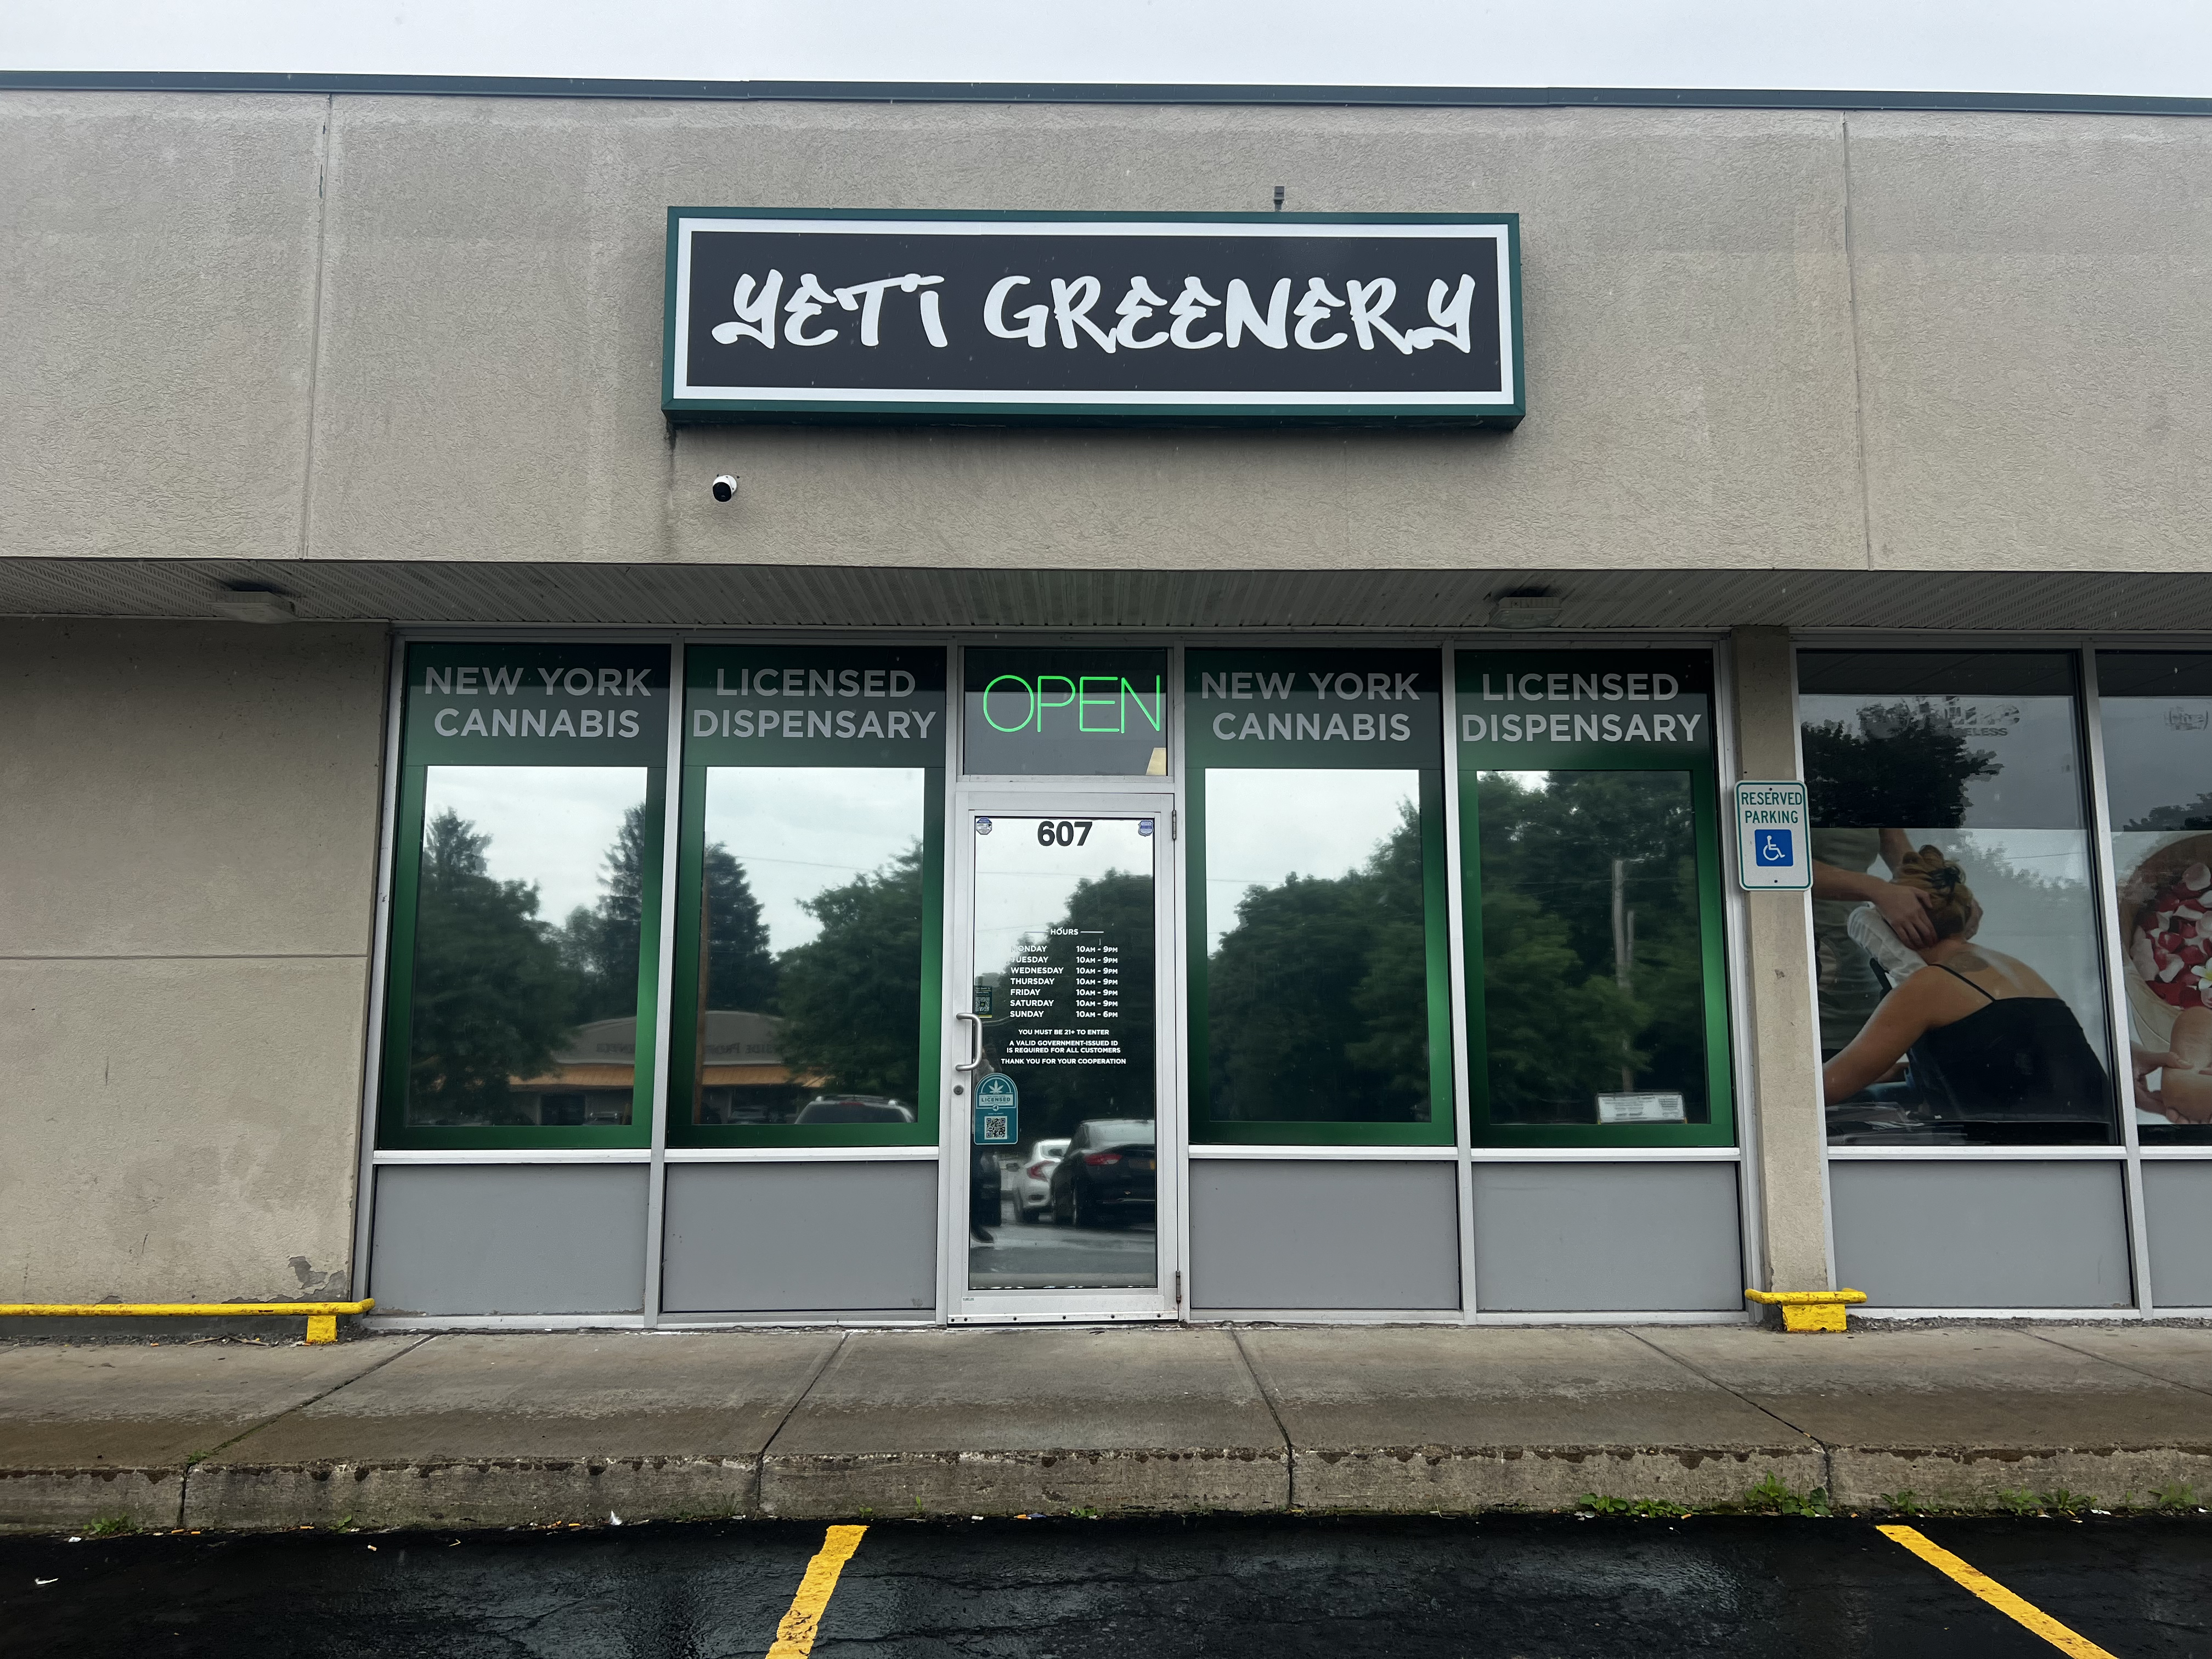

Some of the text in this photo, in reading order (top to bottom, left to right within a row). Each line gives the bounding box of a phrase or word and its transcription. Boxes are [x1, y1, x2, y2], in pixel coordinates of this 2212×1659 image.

[983, 274, 1476, 356] GREENERY
[425, 667, 651, 696] NEW YORK
[716, 668, 915, 698] LICENSED
[1201, 672, 1420, 701] NEW YORK
[1483, 672, 1679, 702] LICENSED
[983, 674, 1160, 733] OPEN
[435, 708, 639, 738] CANNABIS
[693, 708, 936, 739] DISPENSARY
[1212, 712, 1410, 741] CANNABIS
[1463, 713, 1701, 743] DISPENSARY
[1741, 792, 1802, 805] RESERVED
[1745, 810, 1798, 823] PARKING
[1037, 821, 1092, 847] 607
